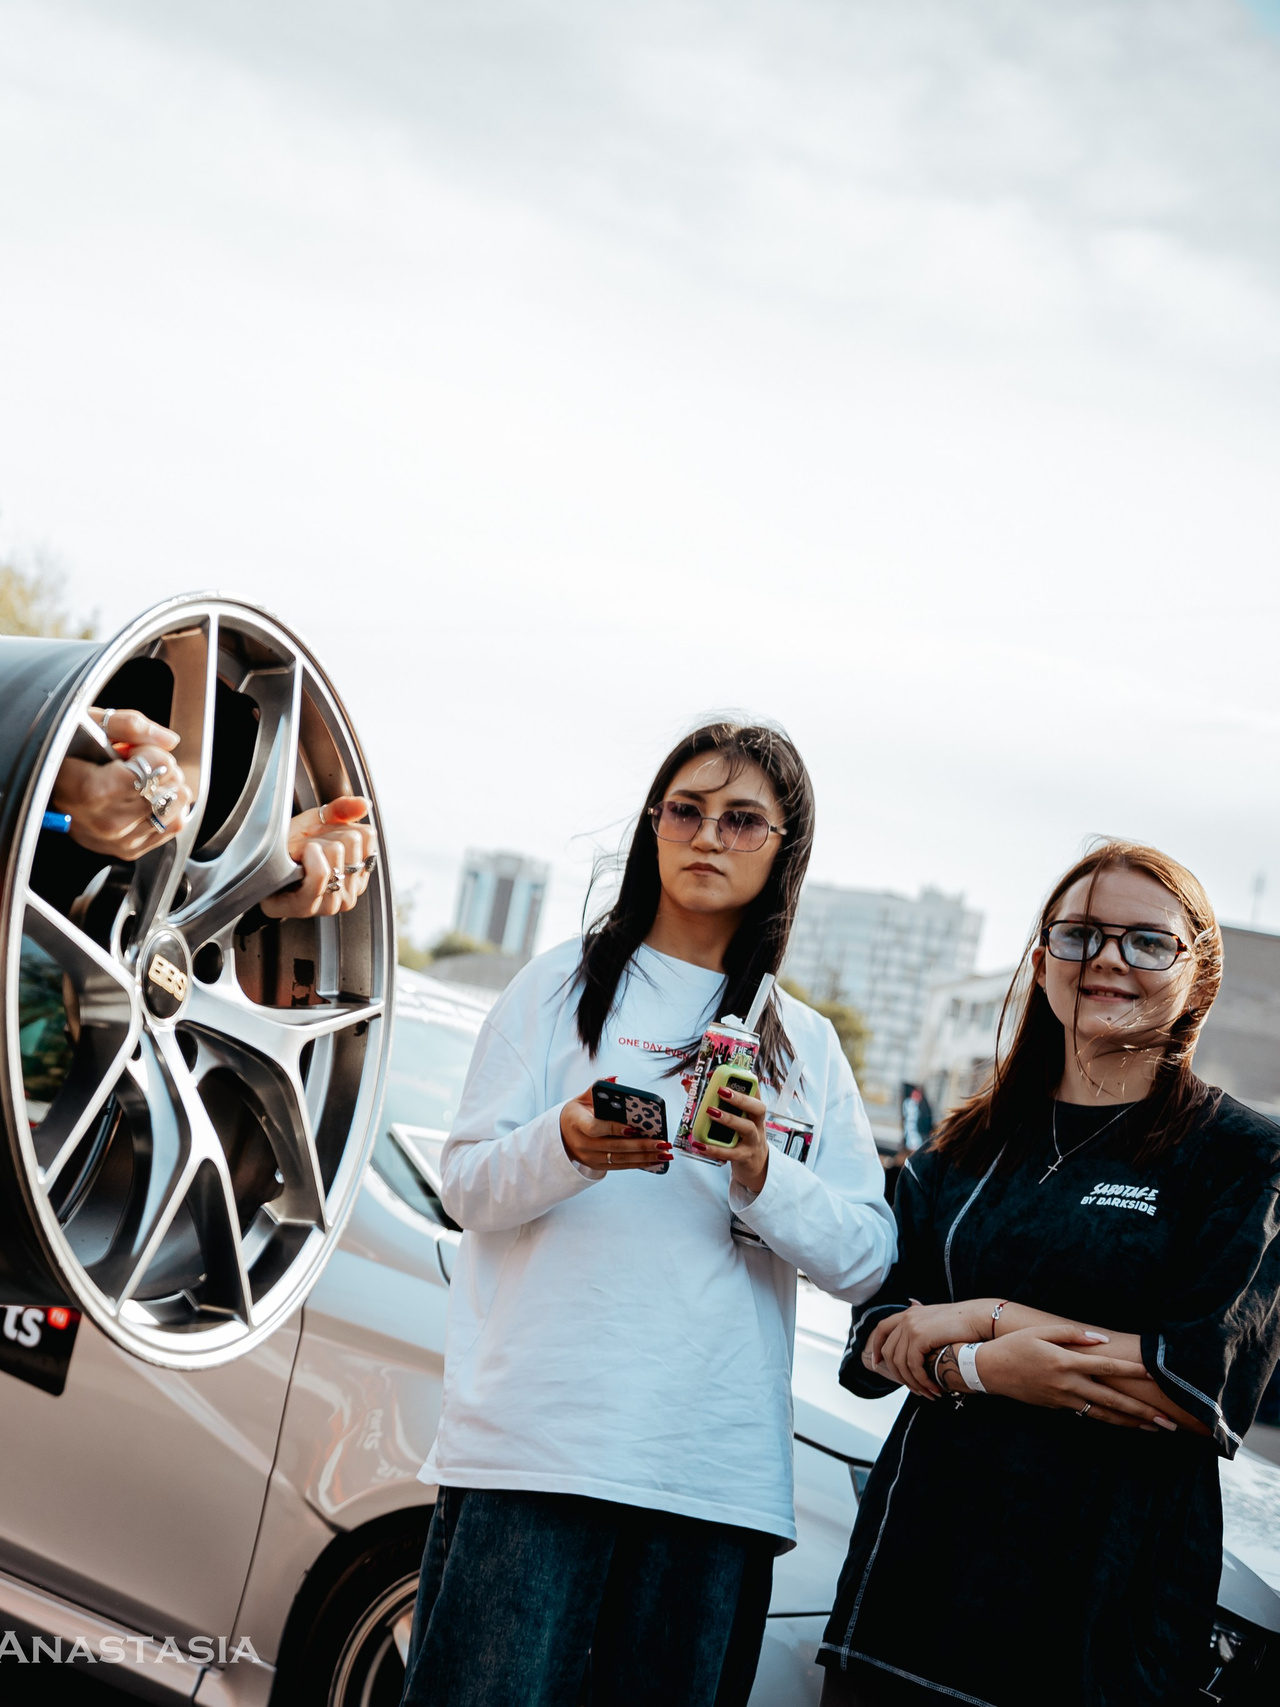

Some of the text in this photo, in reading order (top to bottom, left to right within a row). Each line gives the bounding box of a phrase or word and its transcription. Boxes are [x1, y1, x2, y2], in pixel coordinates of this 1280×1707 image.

[148, 953, 188, 1002] BBS
[618, 1037, 640, 1048] ONE
[643, 1041, 663, 1052] DAY
[682, 1060, 706, 1124] SCANDALIST
[731, 1082, 746, 1092] dojo
[1080, 1196, 1157, 1216] BY DARKSIDE
